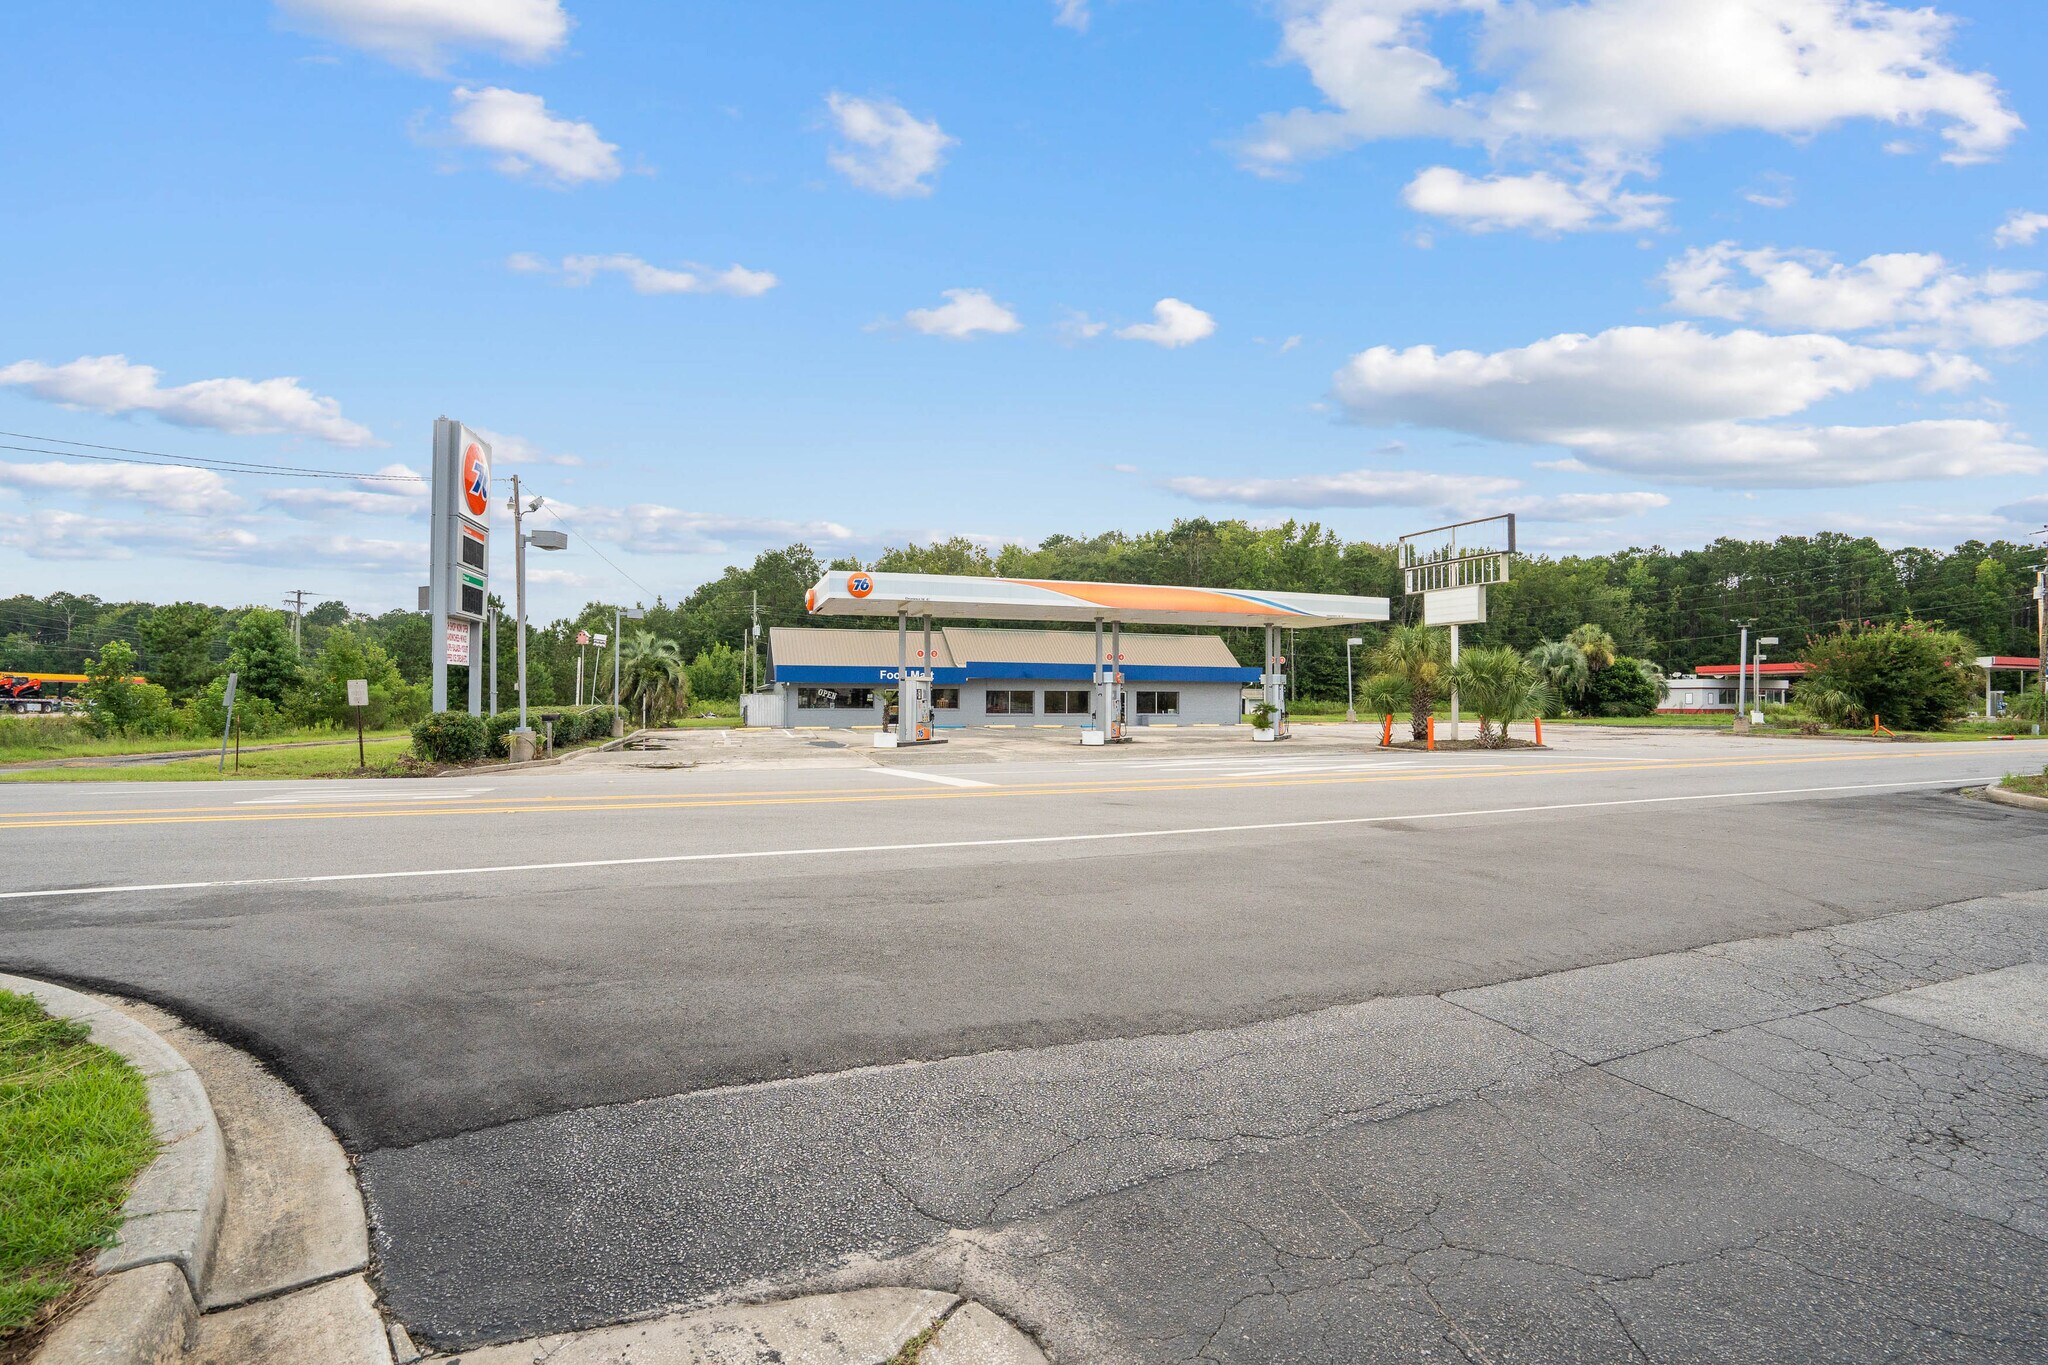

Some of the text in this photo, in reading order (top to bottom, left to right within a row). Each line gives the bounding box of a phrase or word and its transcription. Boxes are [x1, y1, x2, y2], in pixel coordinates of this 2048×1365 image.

[854, 577, 870, 591] 76
[911, 670, 935, 681] Mat
[818, 689, 838, 700] OPEN
